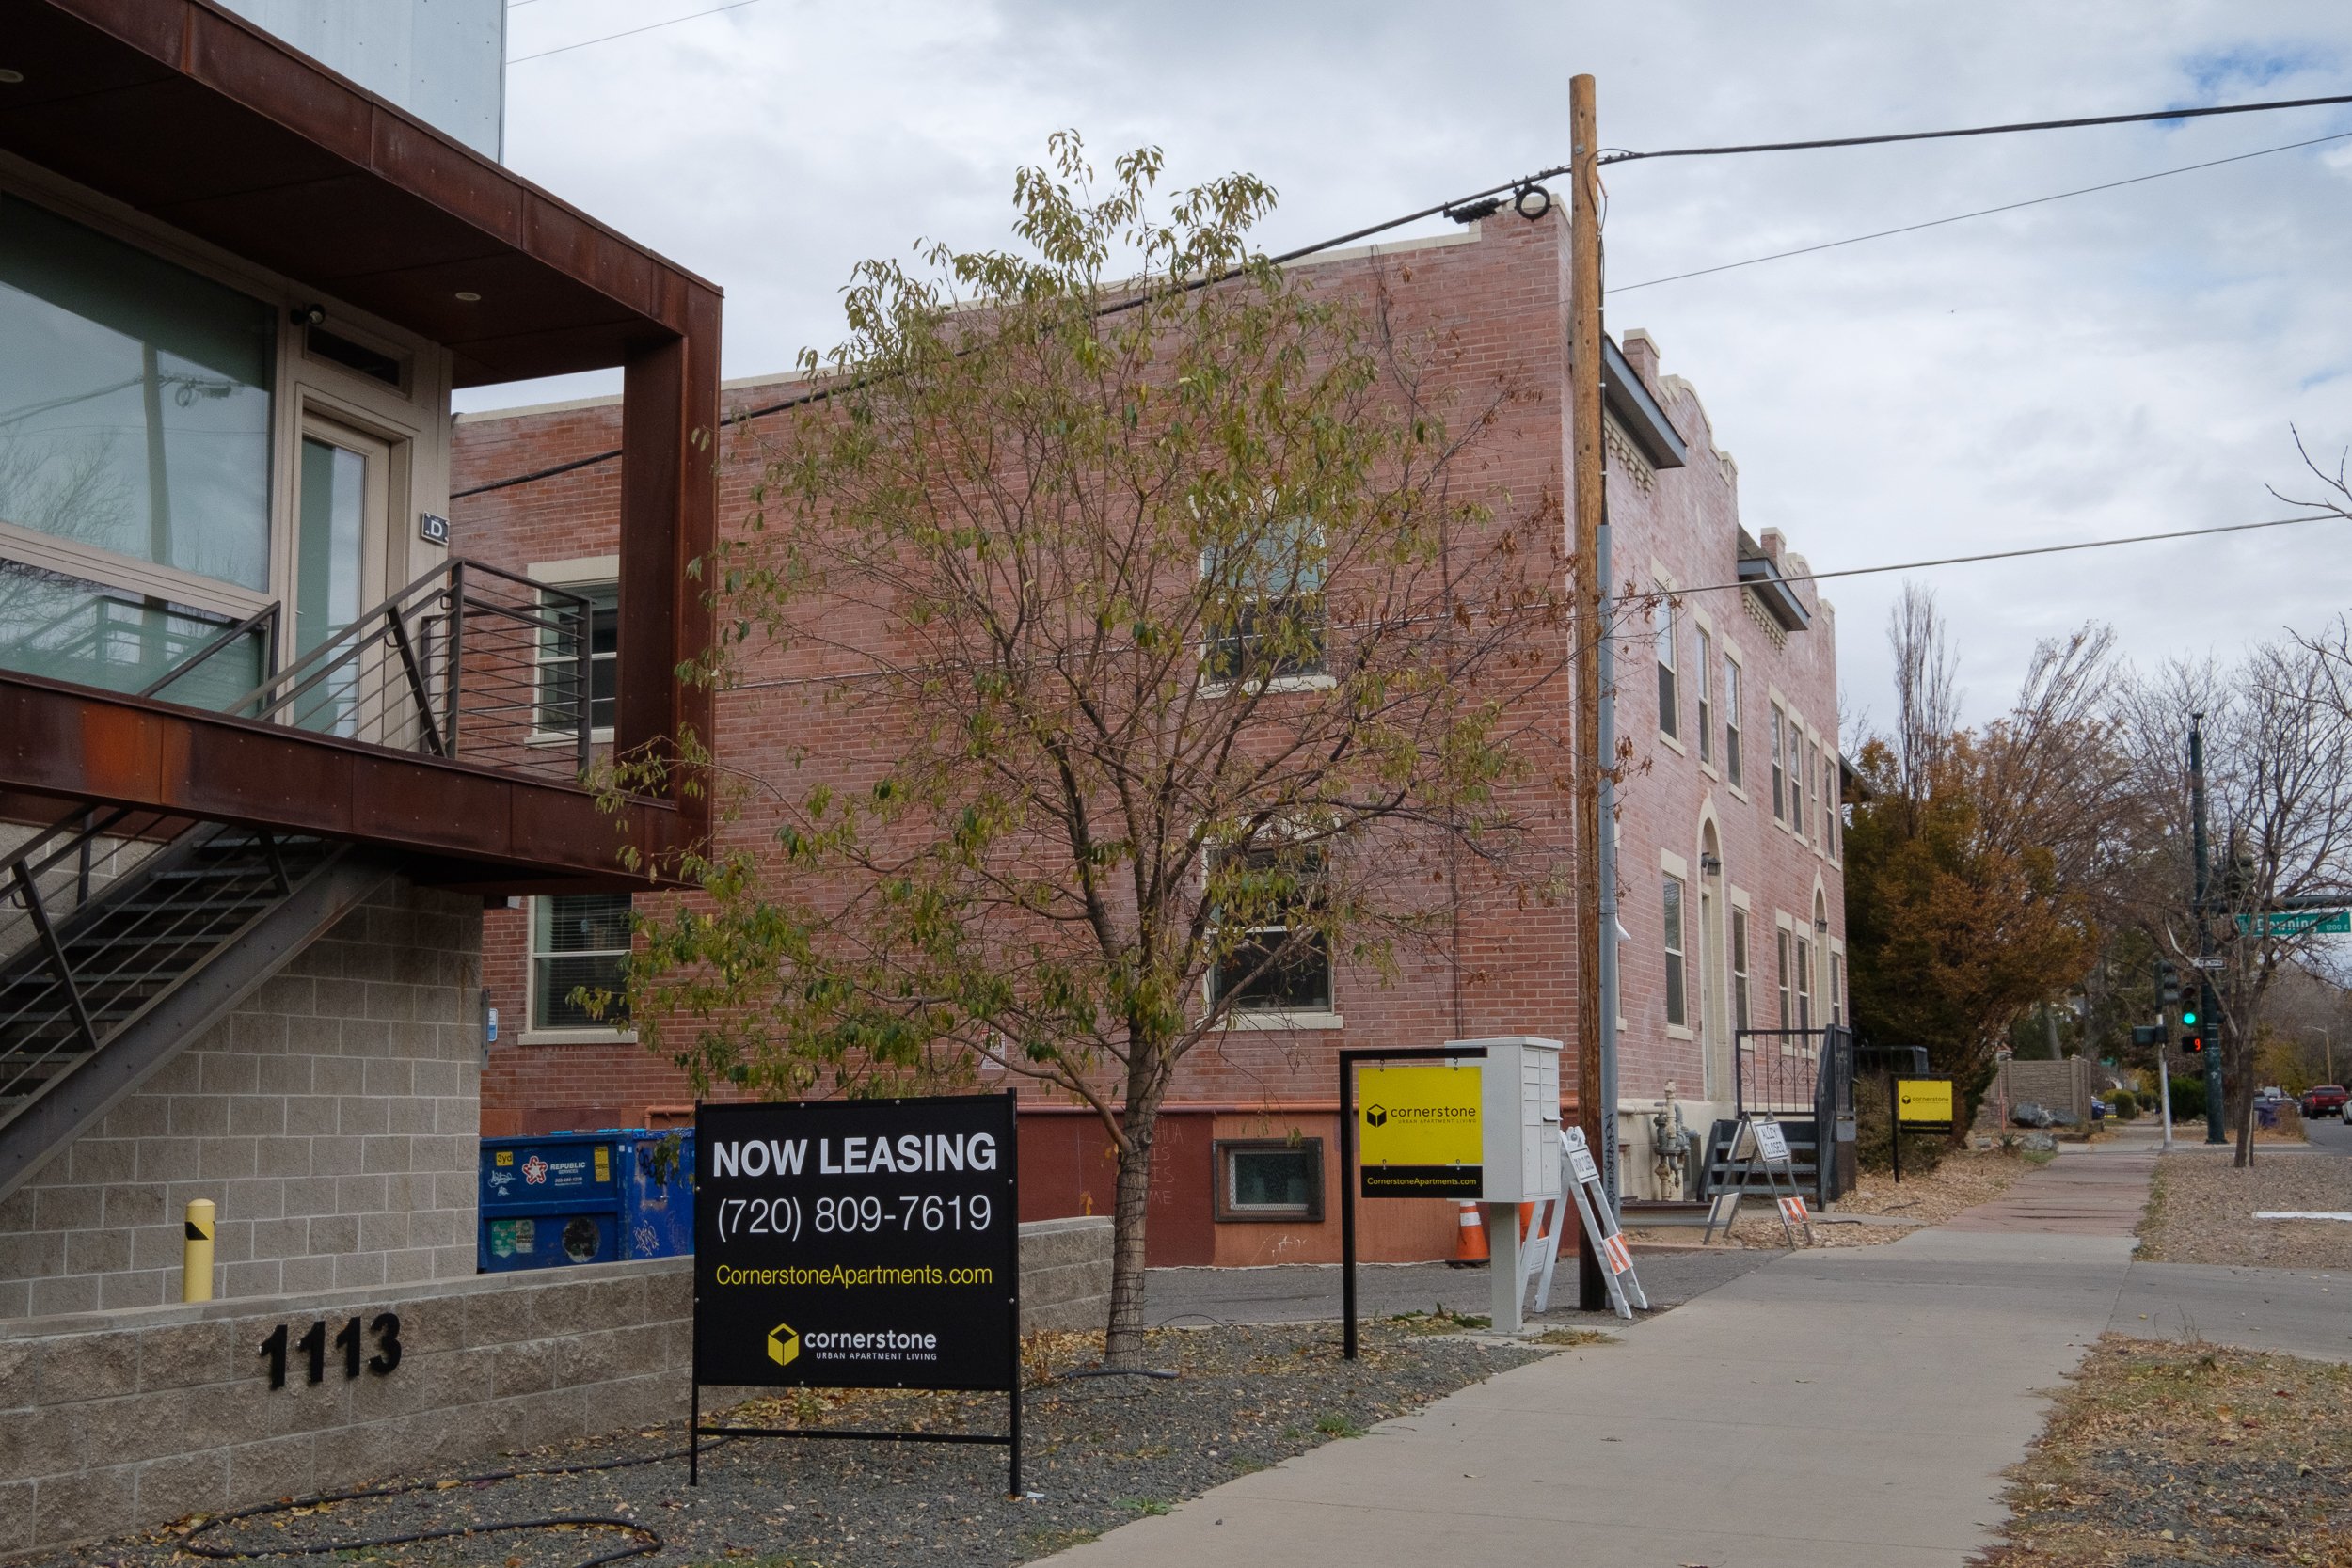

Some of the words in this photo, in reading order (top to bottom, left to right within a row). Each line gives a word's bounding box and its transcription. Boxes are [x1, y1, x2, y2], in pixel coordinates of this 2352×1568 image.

[431, 520, 443, 536] D
[2194, 1037, 2201, 1051] 9
[1391, 1106, 1476, 1117] cornerstone
[714, 1139, 807, 1177] NOW
[820, 1132, 996, 1174] LEASING
[1765, 1141, 1786, 1155] CLOSED
[497, 1153, 513, 1164] 3yd
[550, 1162, 586, 1170] REPUBLIC
[1367, 1177, 1477, 1187] CornerstoneApartments.com
[719, 1197, 801, 1242] (720)
[816, 1195, 992, 1233] 809-7619
[717, 1265, 993, 1289] CornerstoneApartments.com
[805, 1330, 937, 1349] cornerstone
[259, 1312, 402, 1391] 1113
[816, 1352, 846, 1360] URBAN
[849, 1352, 902, 1360] APARTMENT
[906, 1353, 937, 1361] LIVING
